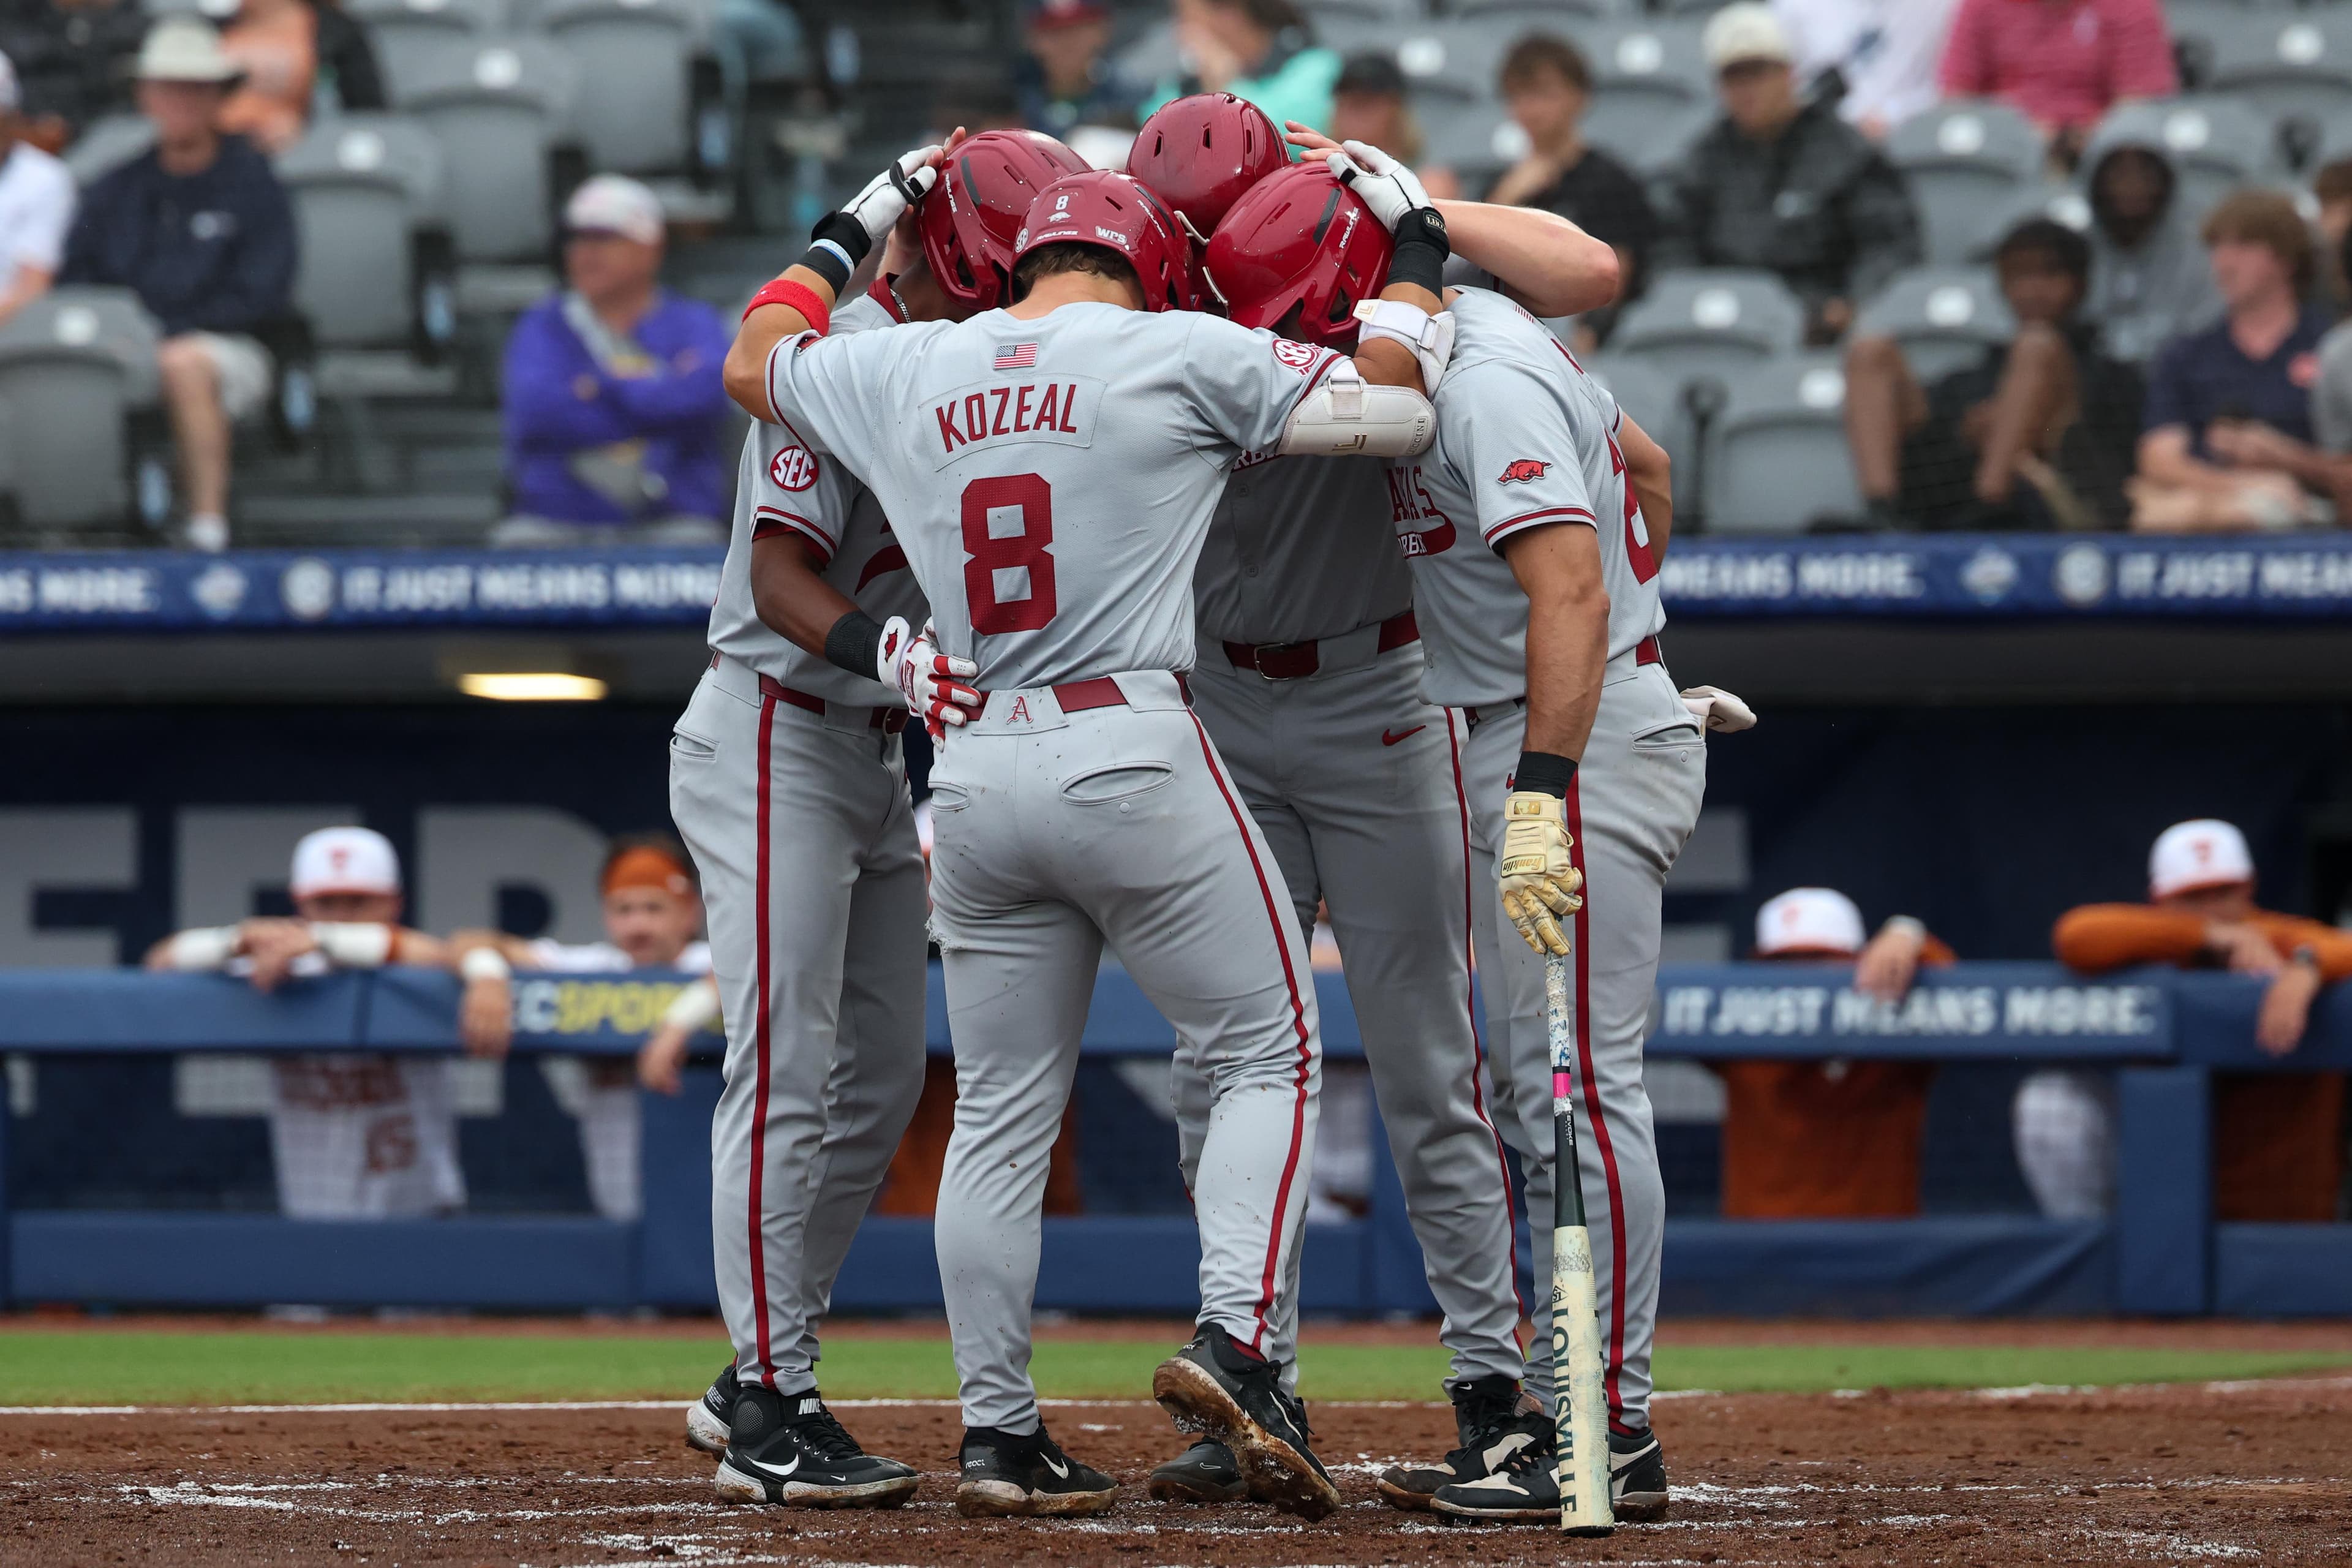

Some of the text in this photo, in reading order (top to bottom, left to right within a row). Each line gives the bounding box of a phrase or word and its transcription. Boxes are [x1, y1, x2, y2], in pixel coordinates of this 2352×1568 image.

[1055, 195, 1069, 210] 8
[1096, 227, 1127, 244] WPS
[1275, 340, 1313, 366] SEC
[935, 383, 1077, 453] KOZEAL
[774, 448, 815, 488] SEC
[960, 472, 1057, 636] 8
[1006, 695, 1033, 724] A
[1663, 987, 1713, 1036] IT
[1714, 987, 1826, 1036] JUST
[798, 1398, 821, 1415] NIKE
[1553, 1306, 1577, 1513] LOUISVILLE
